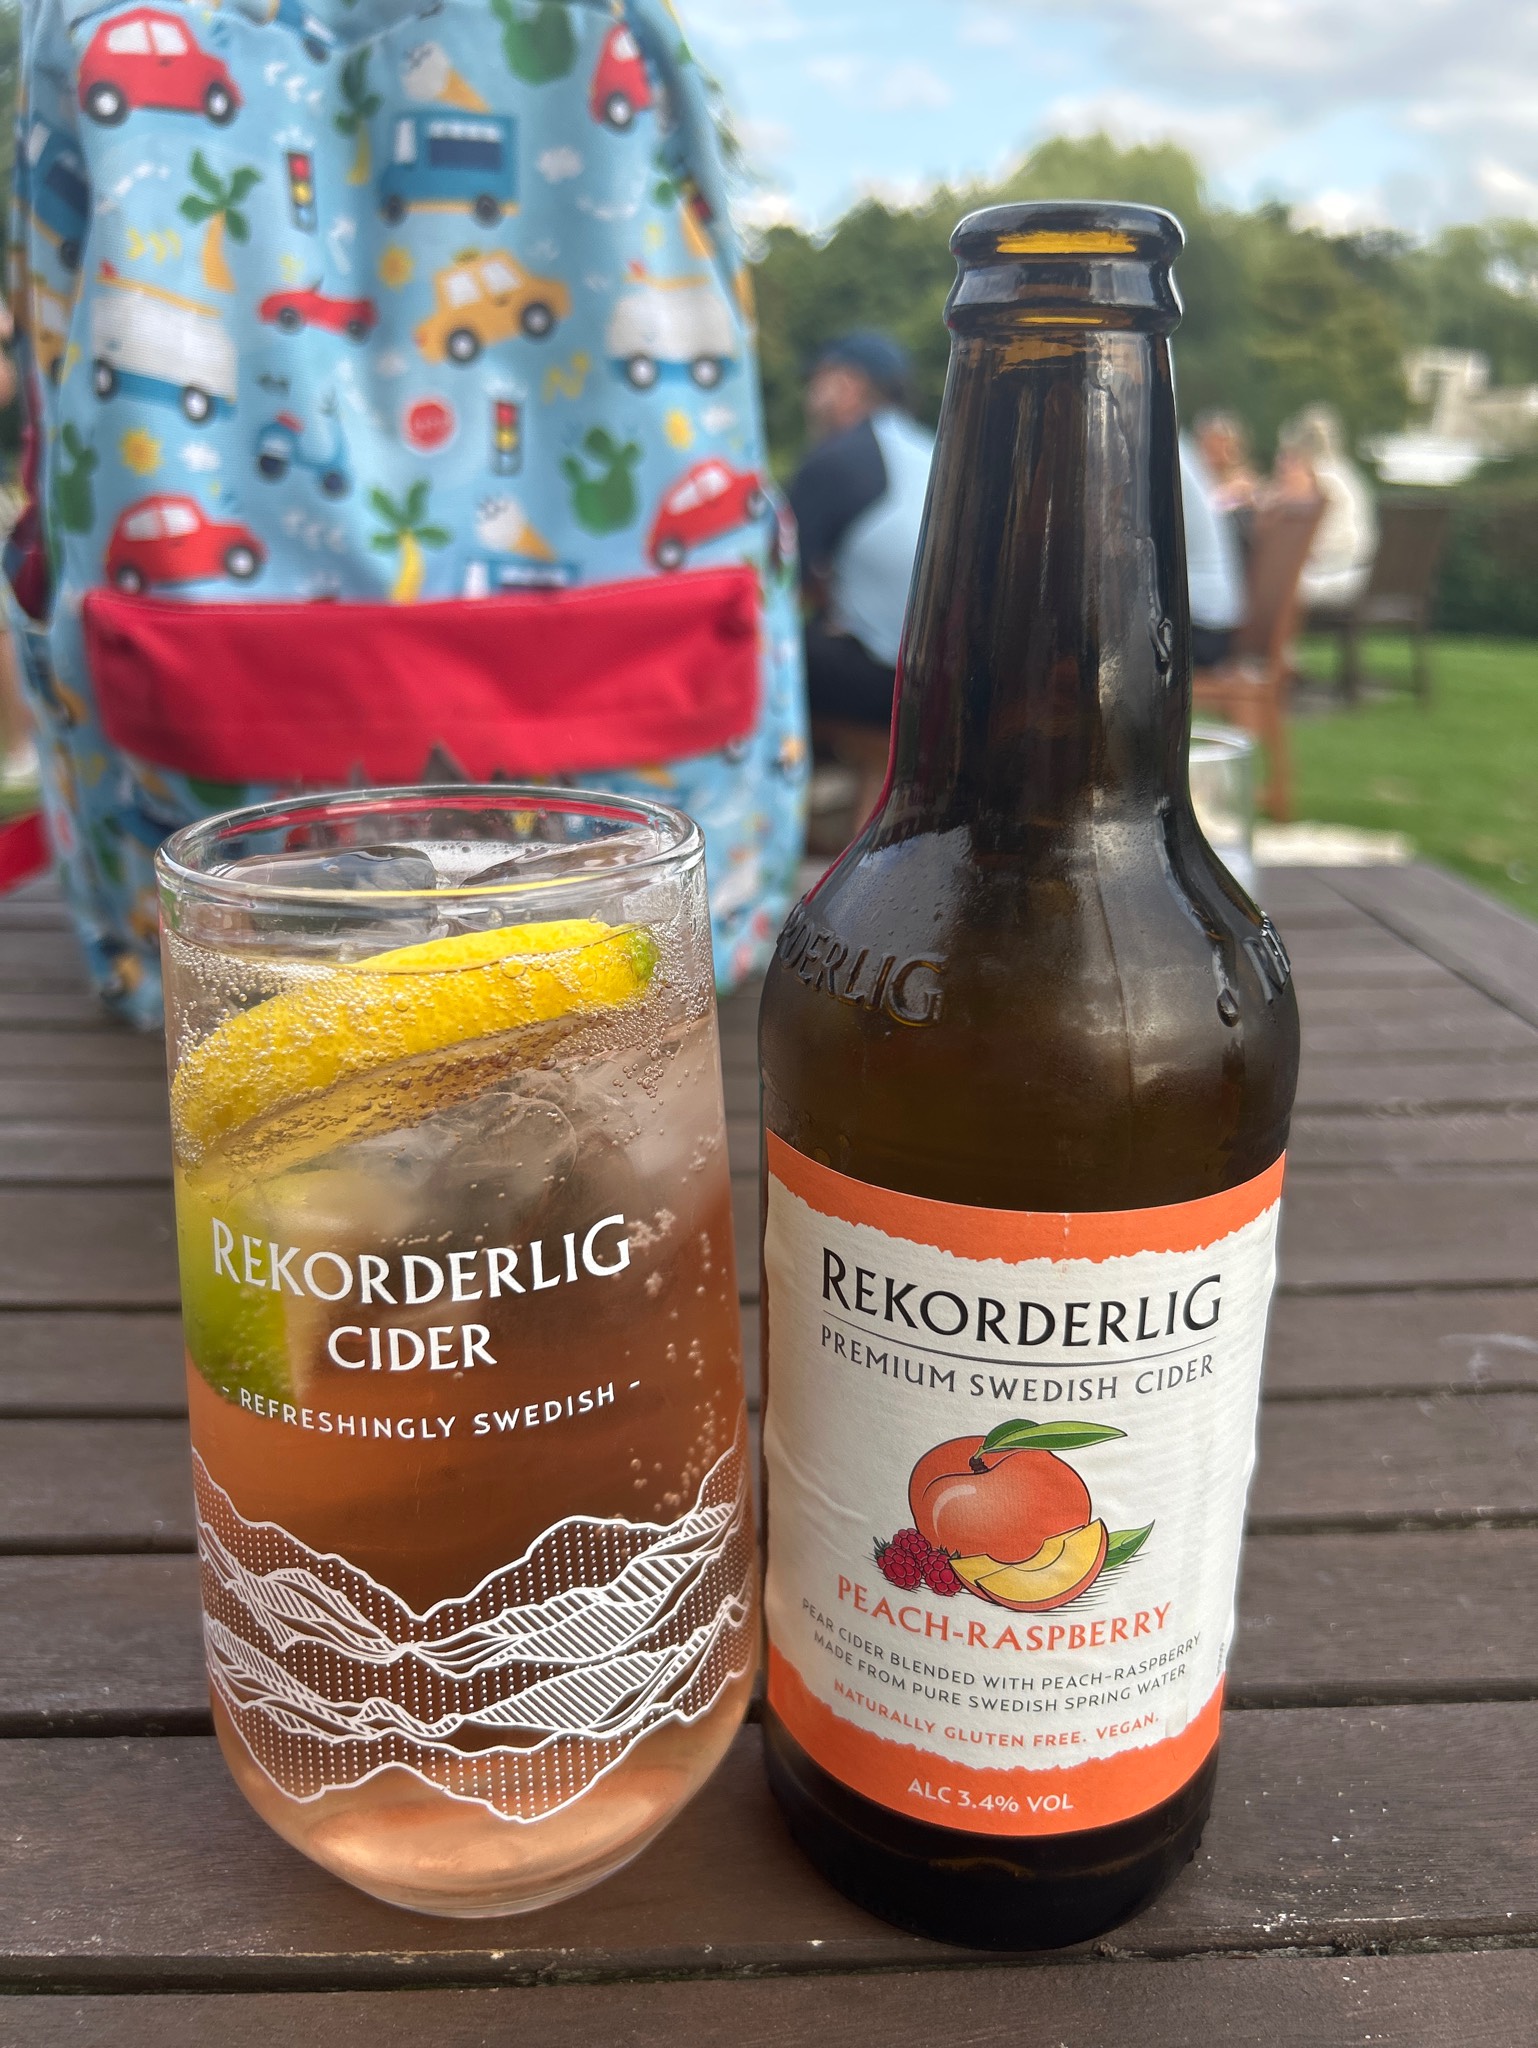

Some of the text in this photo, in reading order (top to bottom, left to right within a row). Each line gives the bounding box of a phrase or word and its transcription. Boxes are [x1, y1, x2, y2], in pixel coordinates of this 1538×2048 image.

[211, 1213, 632, 1305] REKORDERLIG
[821, 1246, 1222, 1348] REKORDERLIG
[327, 1323, 498, 1372] CIDER
[820, 1323, 1214, 1402] PREMIUM SWEDISH CIDER
[239, 1381, 616, 1440] REFRESHINGLY SWEDISH
[802, 1597, 835, 1633] PEAR
[838, 1627, 885, 1660] CIDER
[890, 1651, 976, 1686] BLENDED
[982, 1674, 1034, 1691] WITH
[1041, 1631, 1201, 1690] PEACH-RASPBERRY
[836, 1573, 1172, 1651] PEACH-RASPBERRY
[813, 1630, 1186, 1713] MADE FROM PURE SWEDISH SPRING WATER
[833, 1677, 1160, 1747] NATURALLY GLUTEN FREE. VEGAN.
[907, 1777, 1074, 1813] ALC 3.4% VOL
